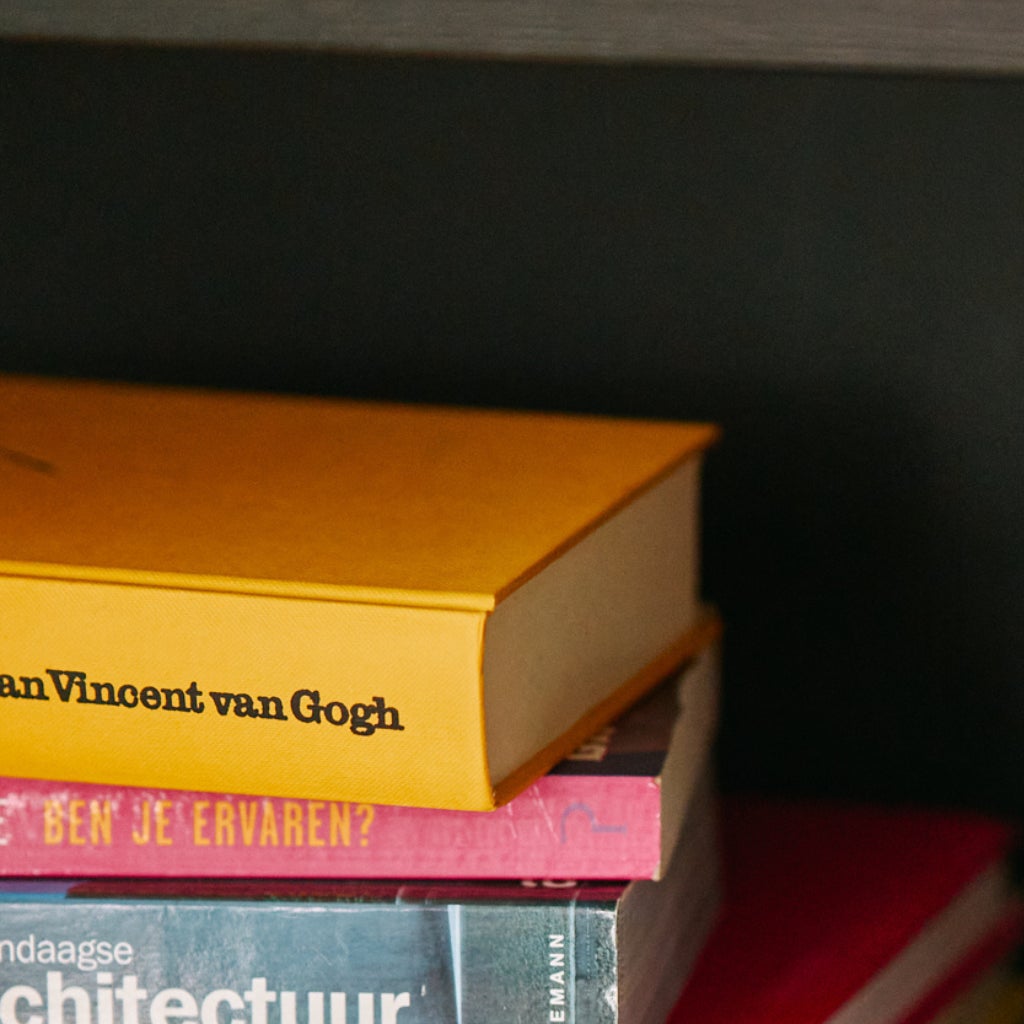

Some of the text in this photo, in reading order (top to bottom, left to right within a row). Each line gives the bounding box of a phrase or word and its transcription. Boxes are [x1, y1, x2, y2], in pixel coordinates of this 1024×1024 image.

[46, 669, 204, 714] Vincent
[210, 691, 288, 721] van
[291, 689, 405, 736] Gogh
[43, 799, 112, 846] BEN
[132, 800, 173, 846] JE
[193, 800, 376, 847] ERVAREN?
[0, 933, 134, 971] ndaagse
